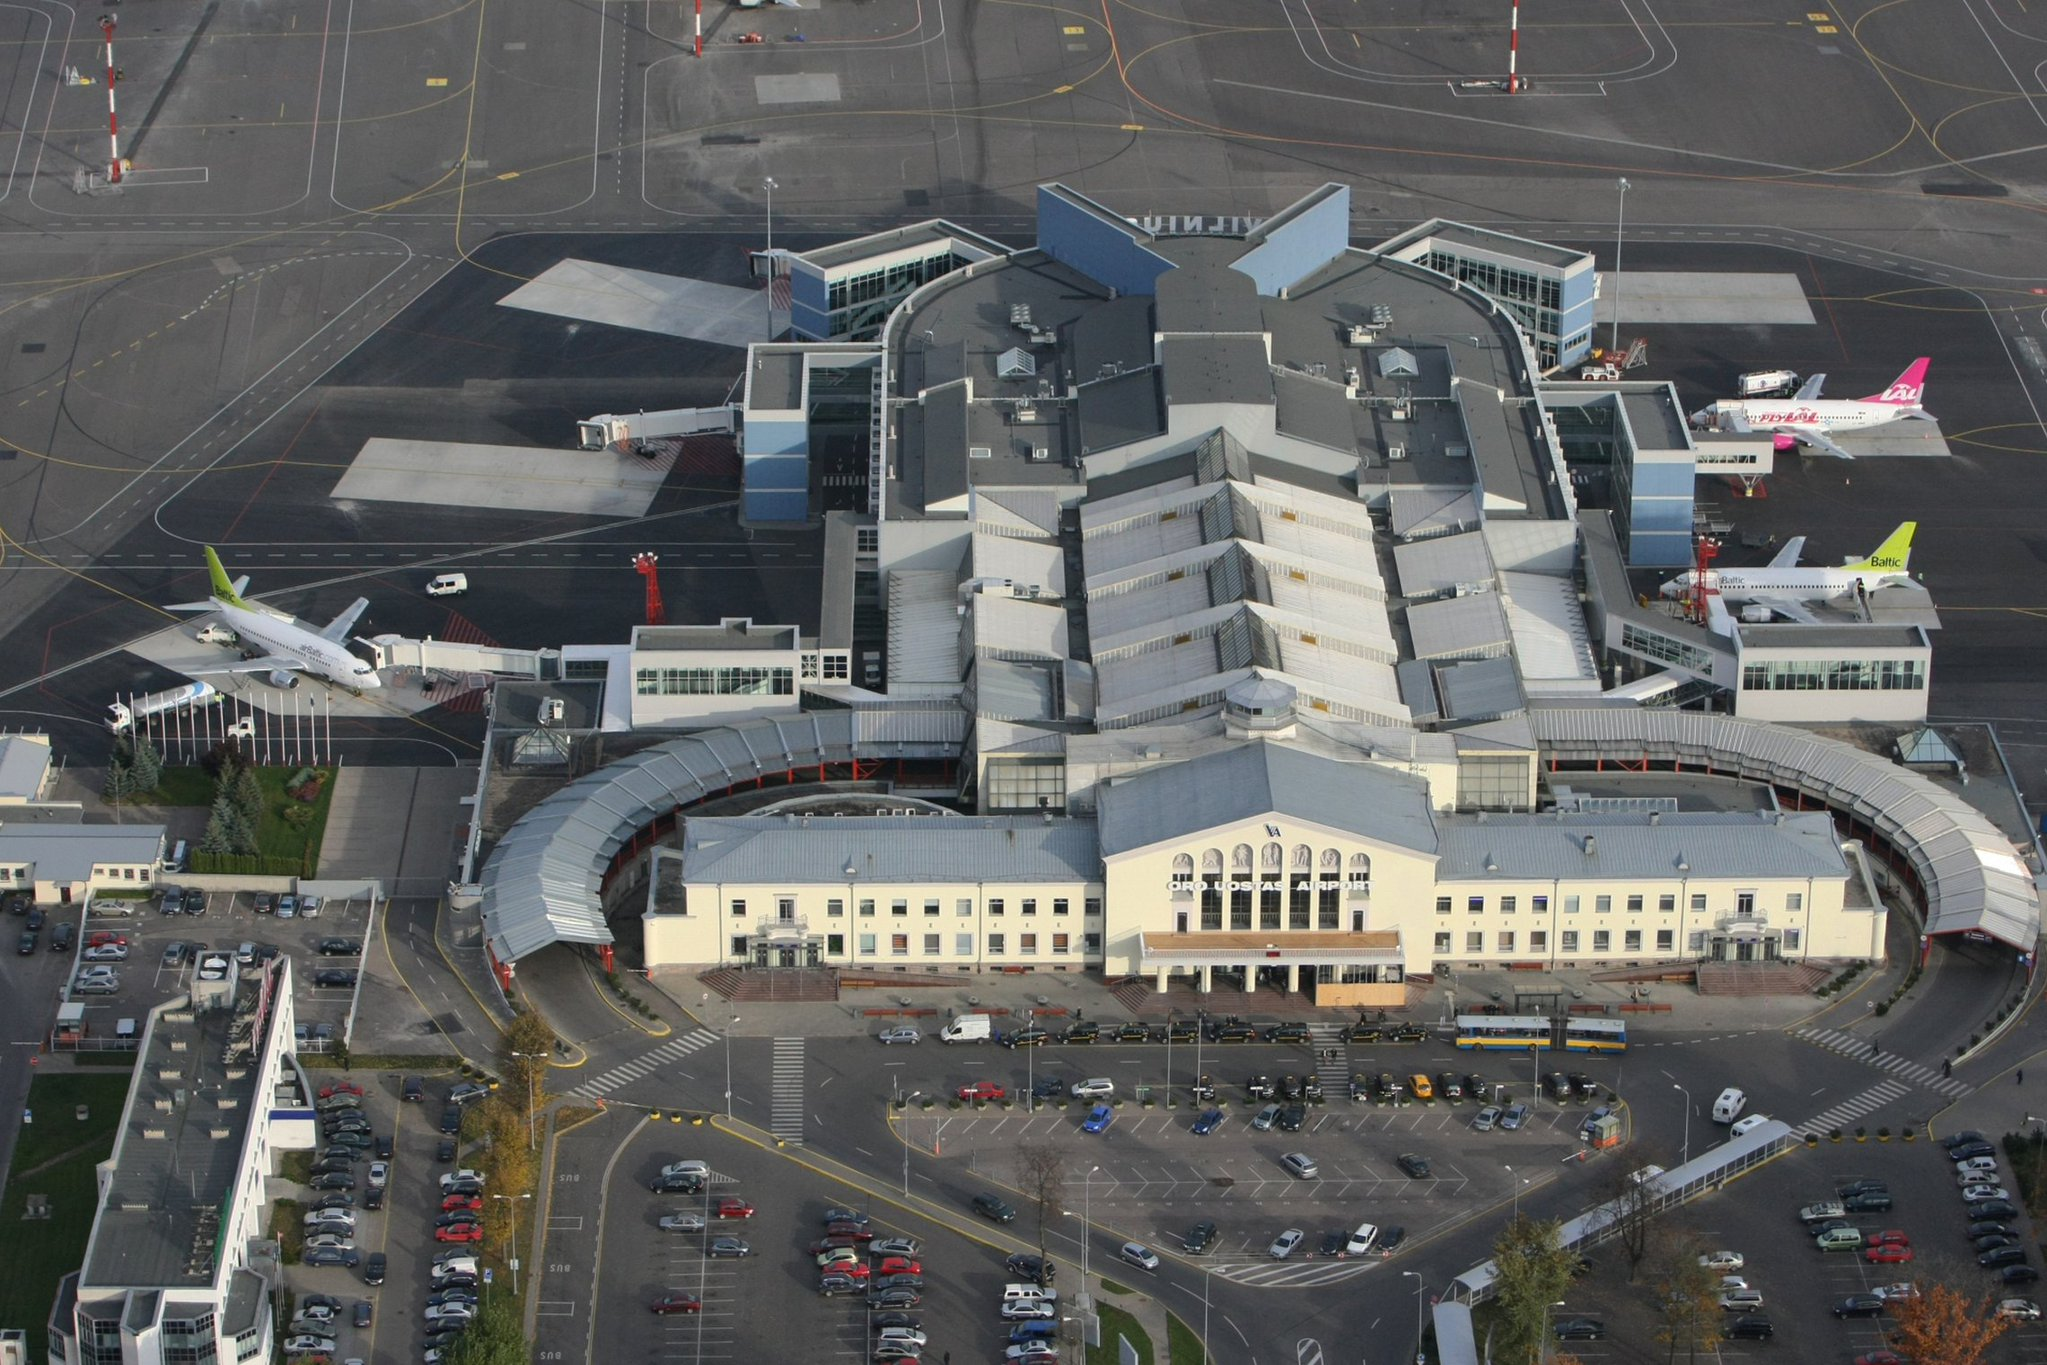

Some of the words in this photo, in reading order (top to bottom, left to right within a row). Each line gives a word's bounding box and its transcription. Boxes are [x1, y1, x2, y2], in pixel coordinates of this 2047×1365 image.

[1871, 556, 1901, 567] Baltic
[1168, 880, 1208, 891] ORO
[1214, 880, 1284, 891] UOSTAS
[1296, 880, 1376, 891] AIRPORT
[559, 1174, 580, 1182] BUS
[550, 1264, 571, 1273] BUS
[540, 1351, 562, 1360] BUS
